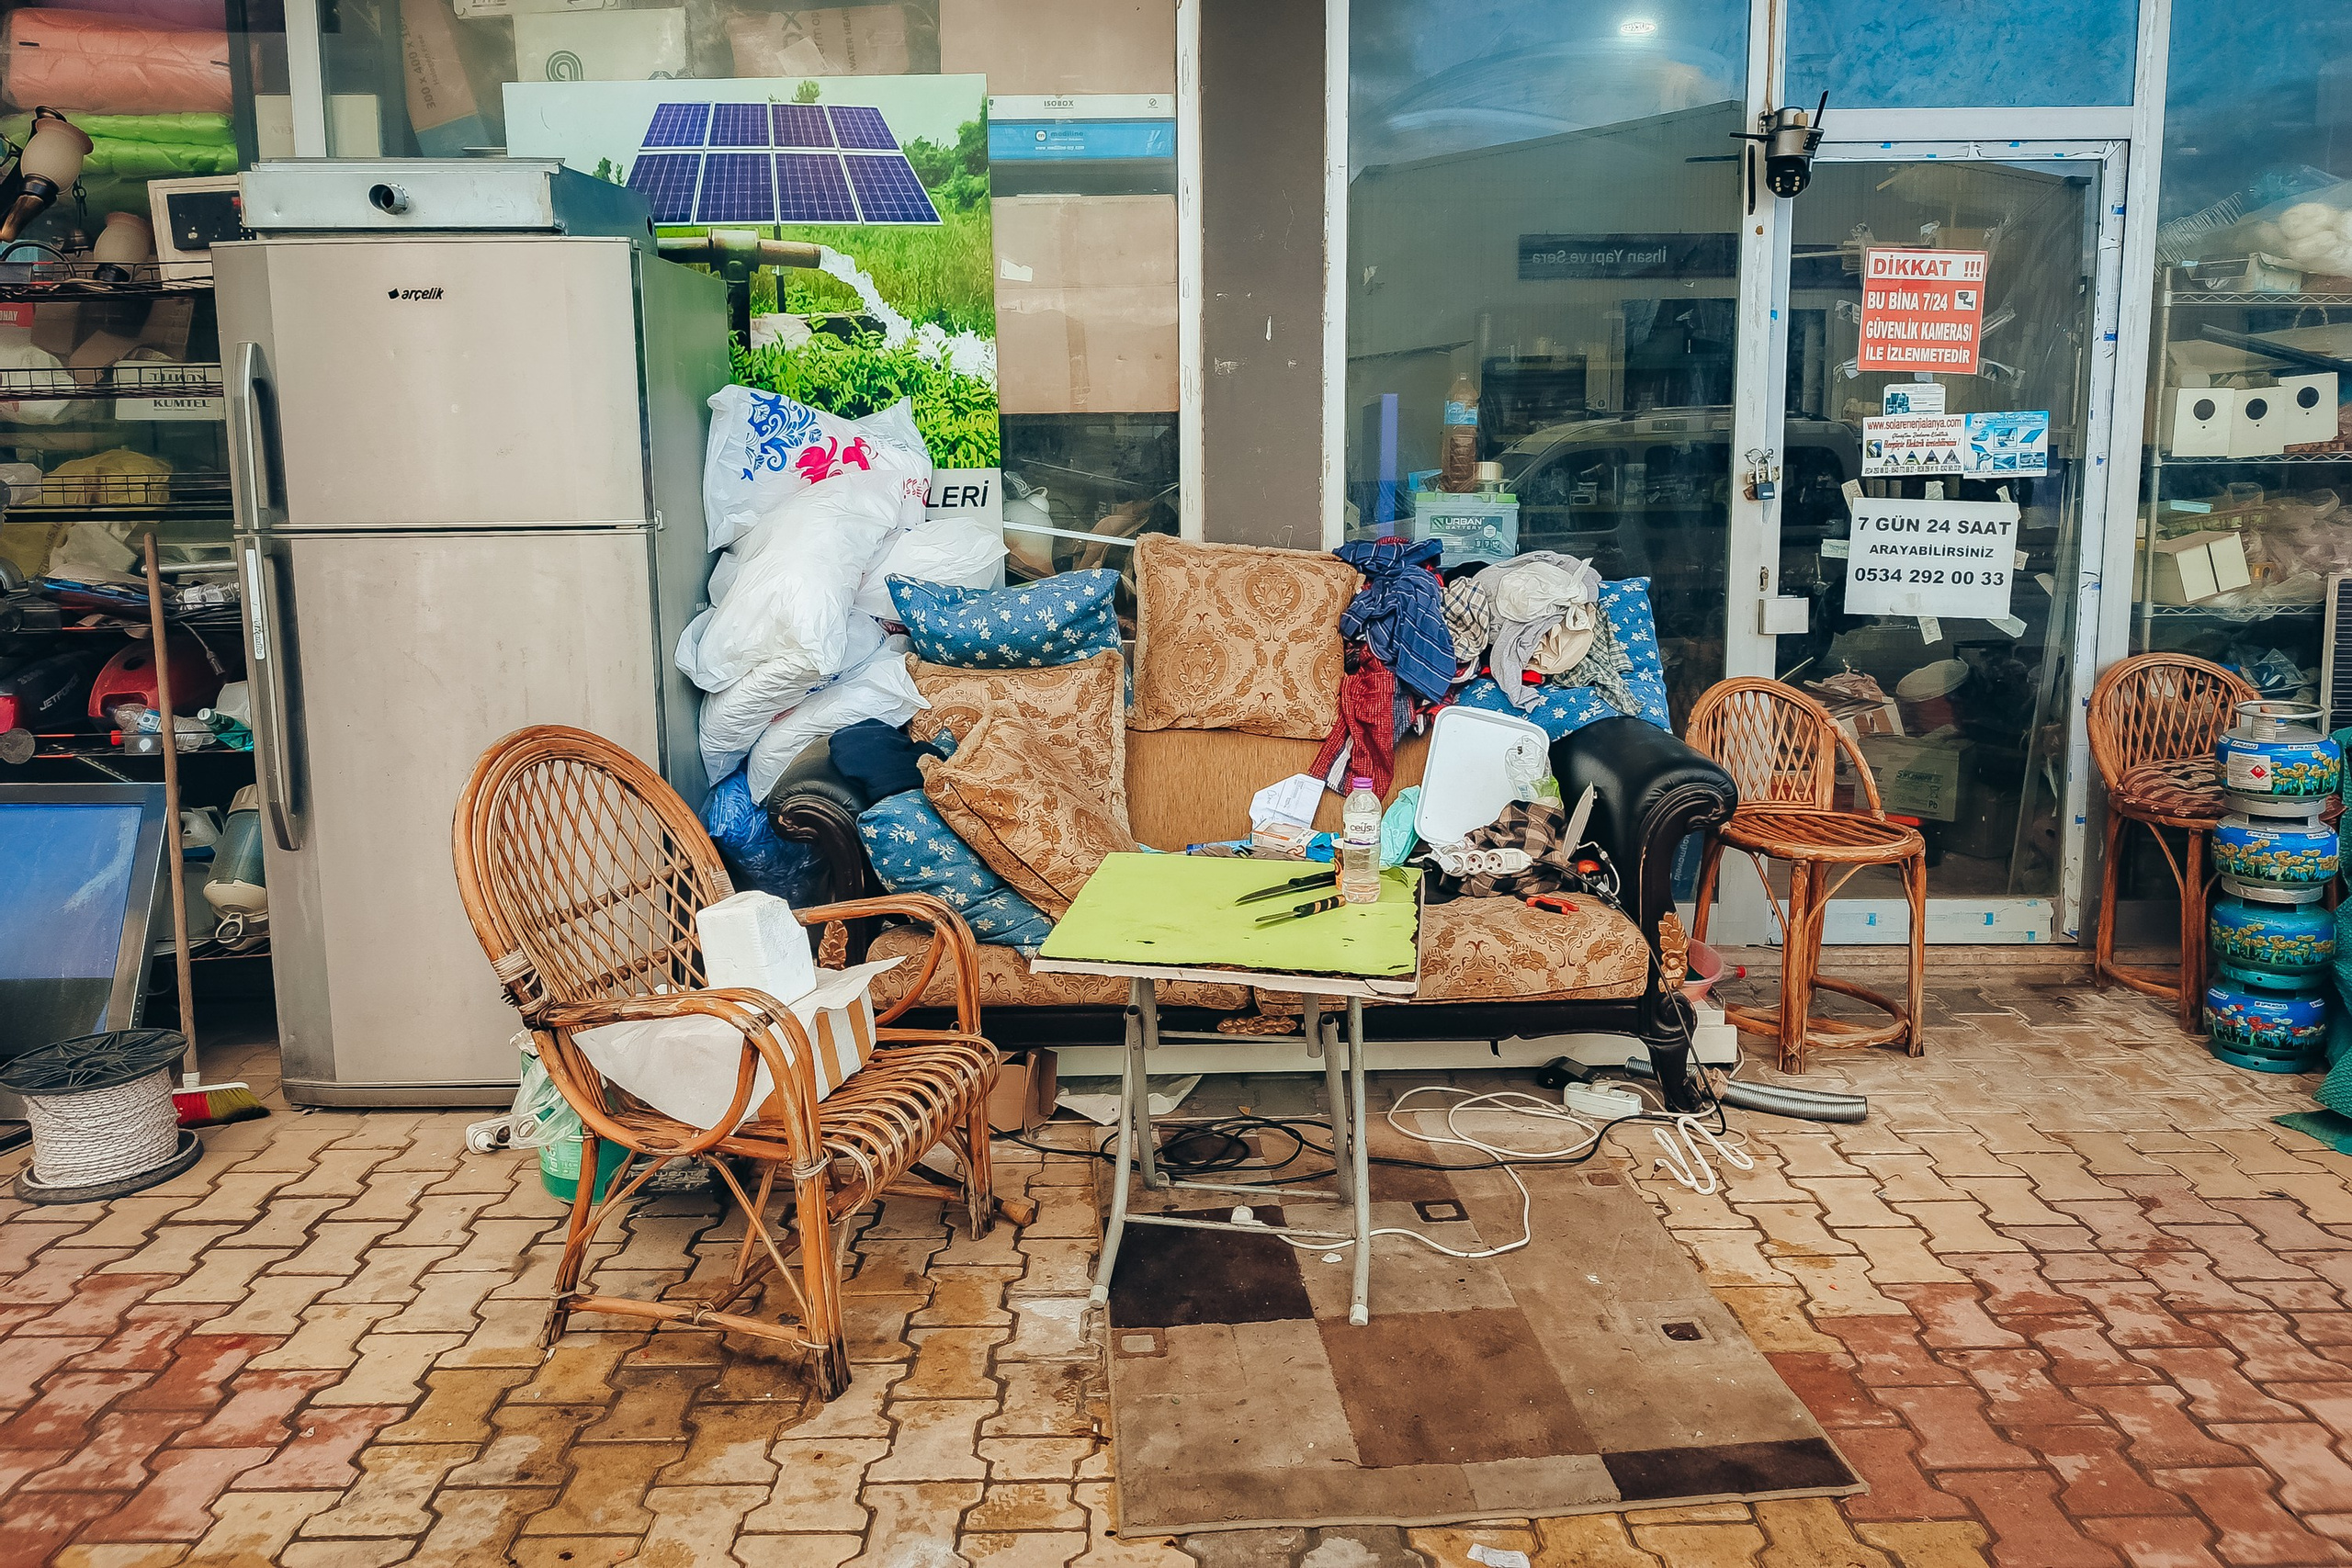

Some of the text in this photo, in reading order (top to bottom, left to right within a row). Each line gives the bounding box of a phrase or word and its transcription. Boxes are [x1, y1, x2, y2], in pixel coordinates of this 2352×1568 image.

[408, 51, 423, 74] 400
[421, 86, 436, 109] 300
[1044, 100, 1075, 108] ISOBOX
[1872, 254, 1952, 277] DİKKAT
[401, 287, 445, 302] arçelik
[1867, 288, 1949, 311] BU BİNA 7/24
[1865, 316, 1973, 342] GÜVENLİK KAMERASI
[1865, 343, 1971, 364] İLE İZLENMETEDİR
[153, 399, 210, 408] KUMTEL
[1866, 417, 1962, 432] www.solarenerjialanya.com
[1445, 517, 1483, 525] URBAN
[1858, 514, 2012, 536] 7 GÜN 24 SAAT
[1869, 544, 1995, 558] ARAYABİLİRSİNİZ
[1854, 567, 2005, 586] 0534 292 00 33
[1928, 799, 1939, 809] Pb
